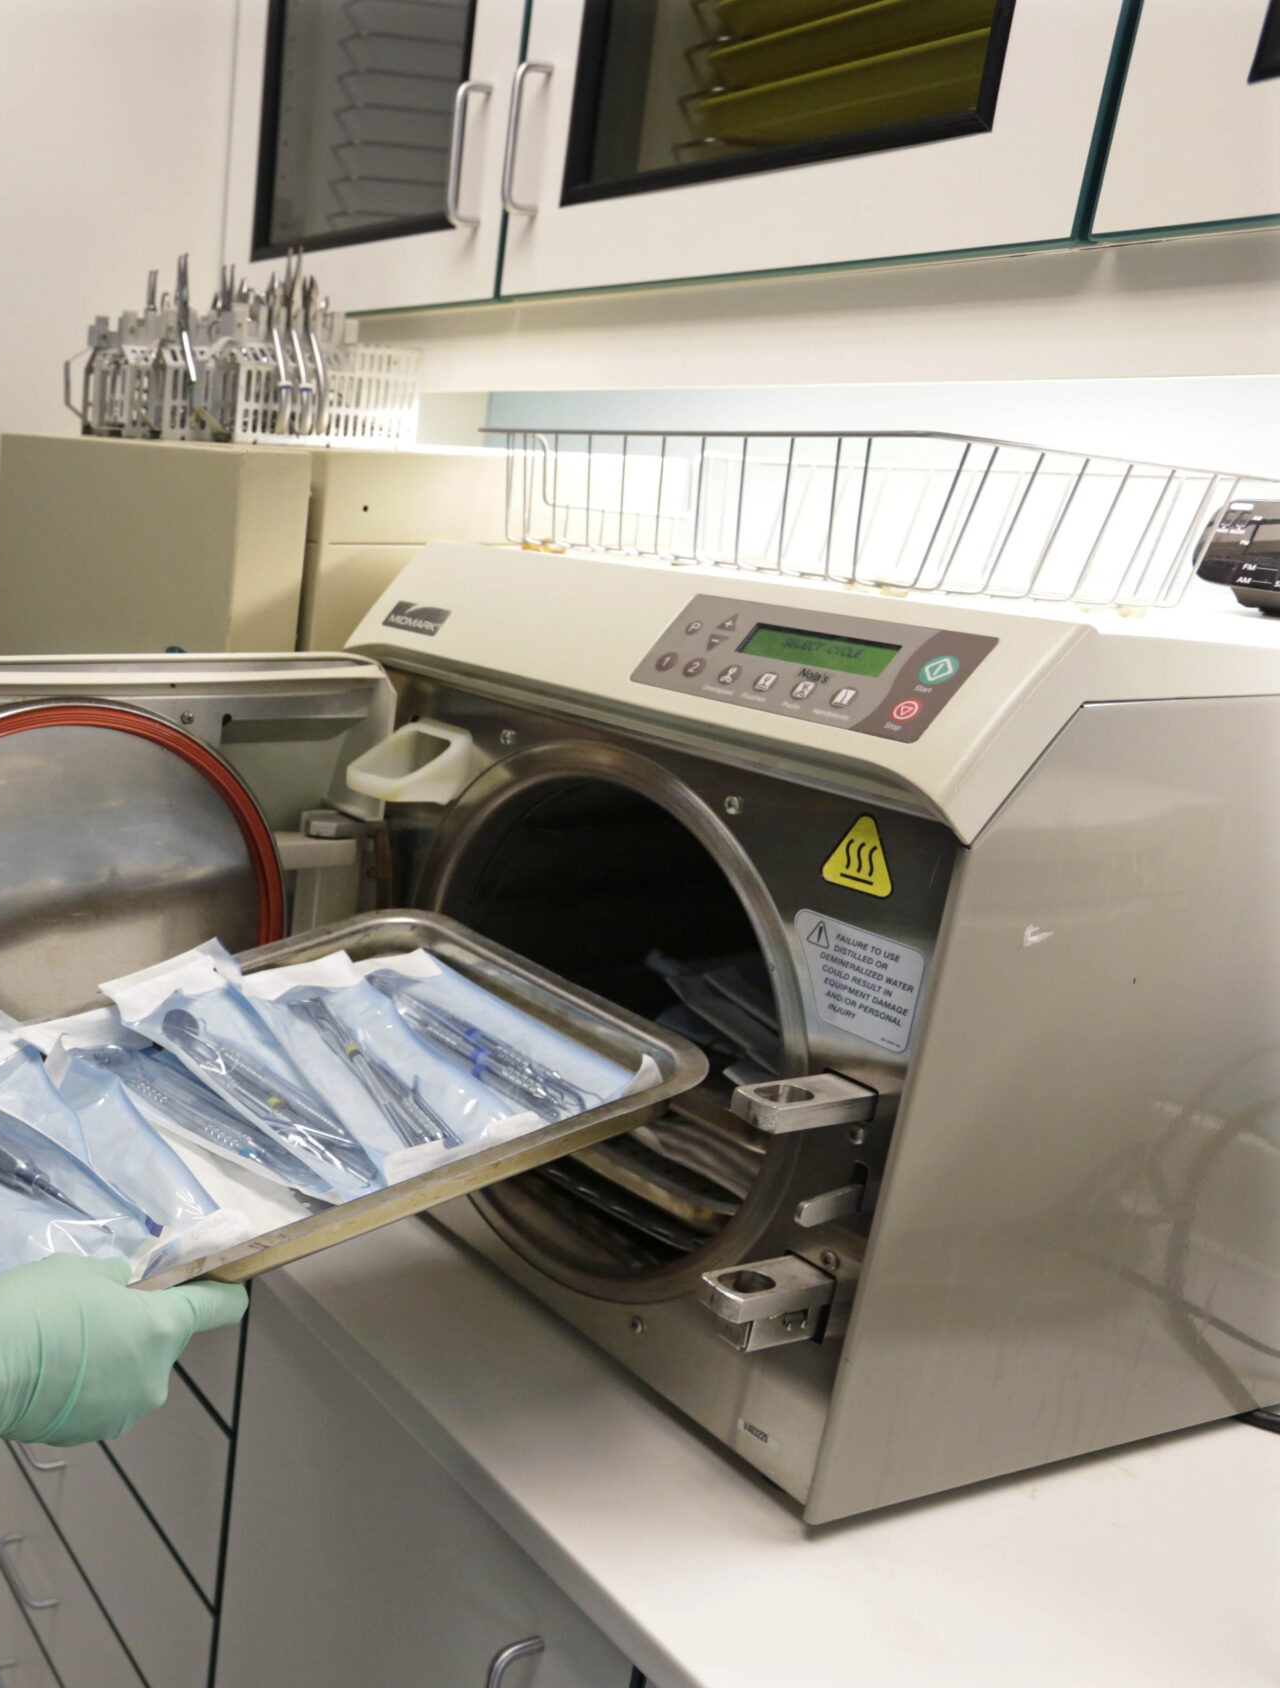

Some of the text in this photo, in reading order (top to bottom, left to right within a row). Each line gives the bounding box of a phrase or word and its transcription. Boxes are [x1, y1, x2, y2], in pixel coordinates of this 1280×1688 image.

[387, 614, 437, 632] MIDMARK
[687, 621, 702, 634] P
[782, 638, 864, 659] SELECT CYCLE
[662, 656, 701, 673] 1 2
[914, 685, 933, 693] Start
[884, 722, 902, 731] Stop
[833, 945, 889, 970] DISTILLED OR
[836, 933, 901, 963] FAILURE TO USE
[819, 951, 914, 993] DEMINERALIZED WATER
[822, 964, 893, 997] COULD RESULT IN
[823, 977, 909, 1016] EQUIPMENT DAMAGE
[825, 990, 902, 1027] AND/OR PERSONAL
[827, 1002, 857, 1019] INJURY
